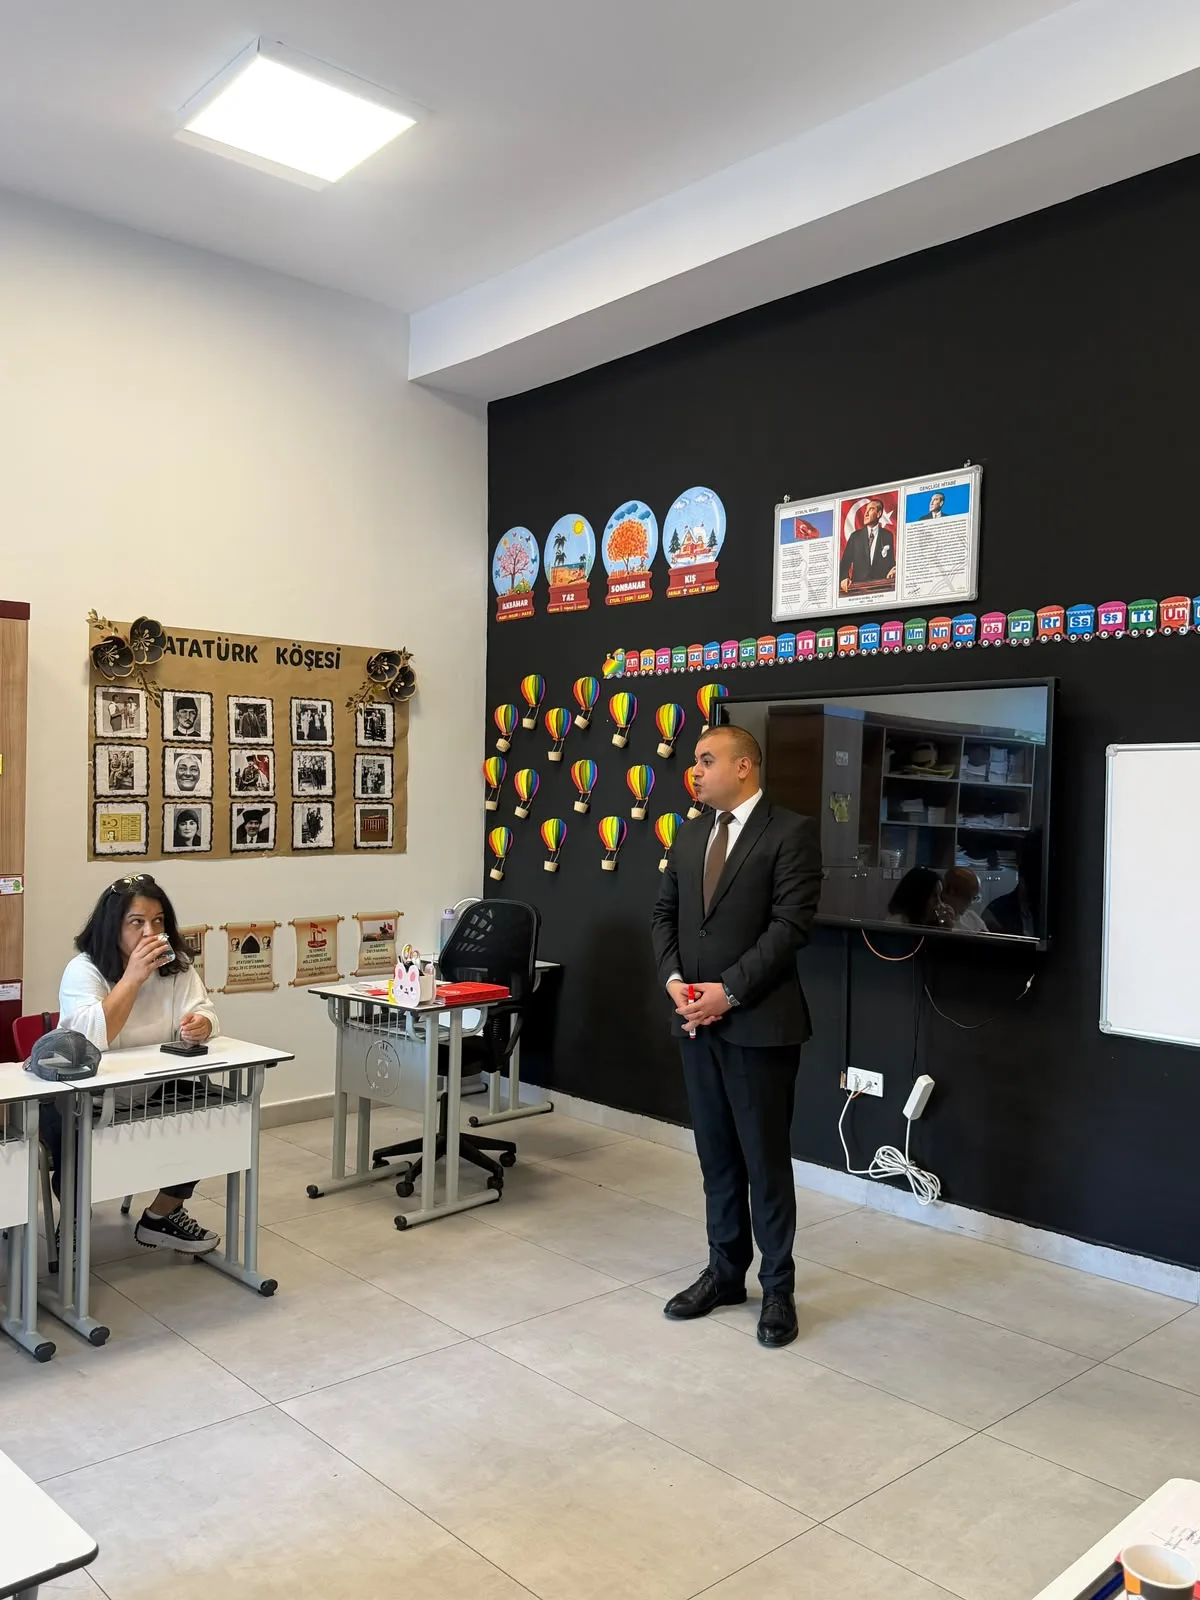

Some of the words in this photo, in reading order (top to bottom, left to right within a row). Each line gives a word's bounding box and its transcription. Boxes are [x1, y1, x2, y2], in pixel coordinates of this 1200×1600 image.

[684, 574, 697, 585] KIŞ
[610, 580, 646, 593] SONBAHAR
[561, 593, 575, 602] YAZ
[642, 657, 653, 666] Bb
[657, 656, 669, 664] Cc
[690, 653, 700, 661] Dd
[706, 651, 718, 660] Ee
[724, 649, 734, 658] Ff
[779, 642, 793, 652] Hh
[863, 634, 876, 643] Kk
[886, 631, 898, 641] Ll
[907, 628, 923, 639] Mm
[932, 627, 948, 637] Nn
[956, 625, 972, 635] Oo
[984, 623, 999, 633] Öö
[1012, 621, 1029, 632] Pp
[1041, 617, 1059, 628] Rr
[1071, 616, 1089, 627] Ss
[1133, 610, 1150, 622] Tt
[1165, 608, 1186, 620] Uu
[164, 636, 259, 664] ATATÜRK
[276, 643, 341, 671] KÖŞESİ
